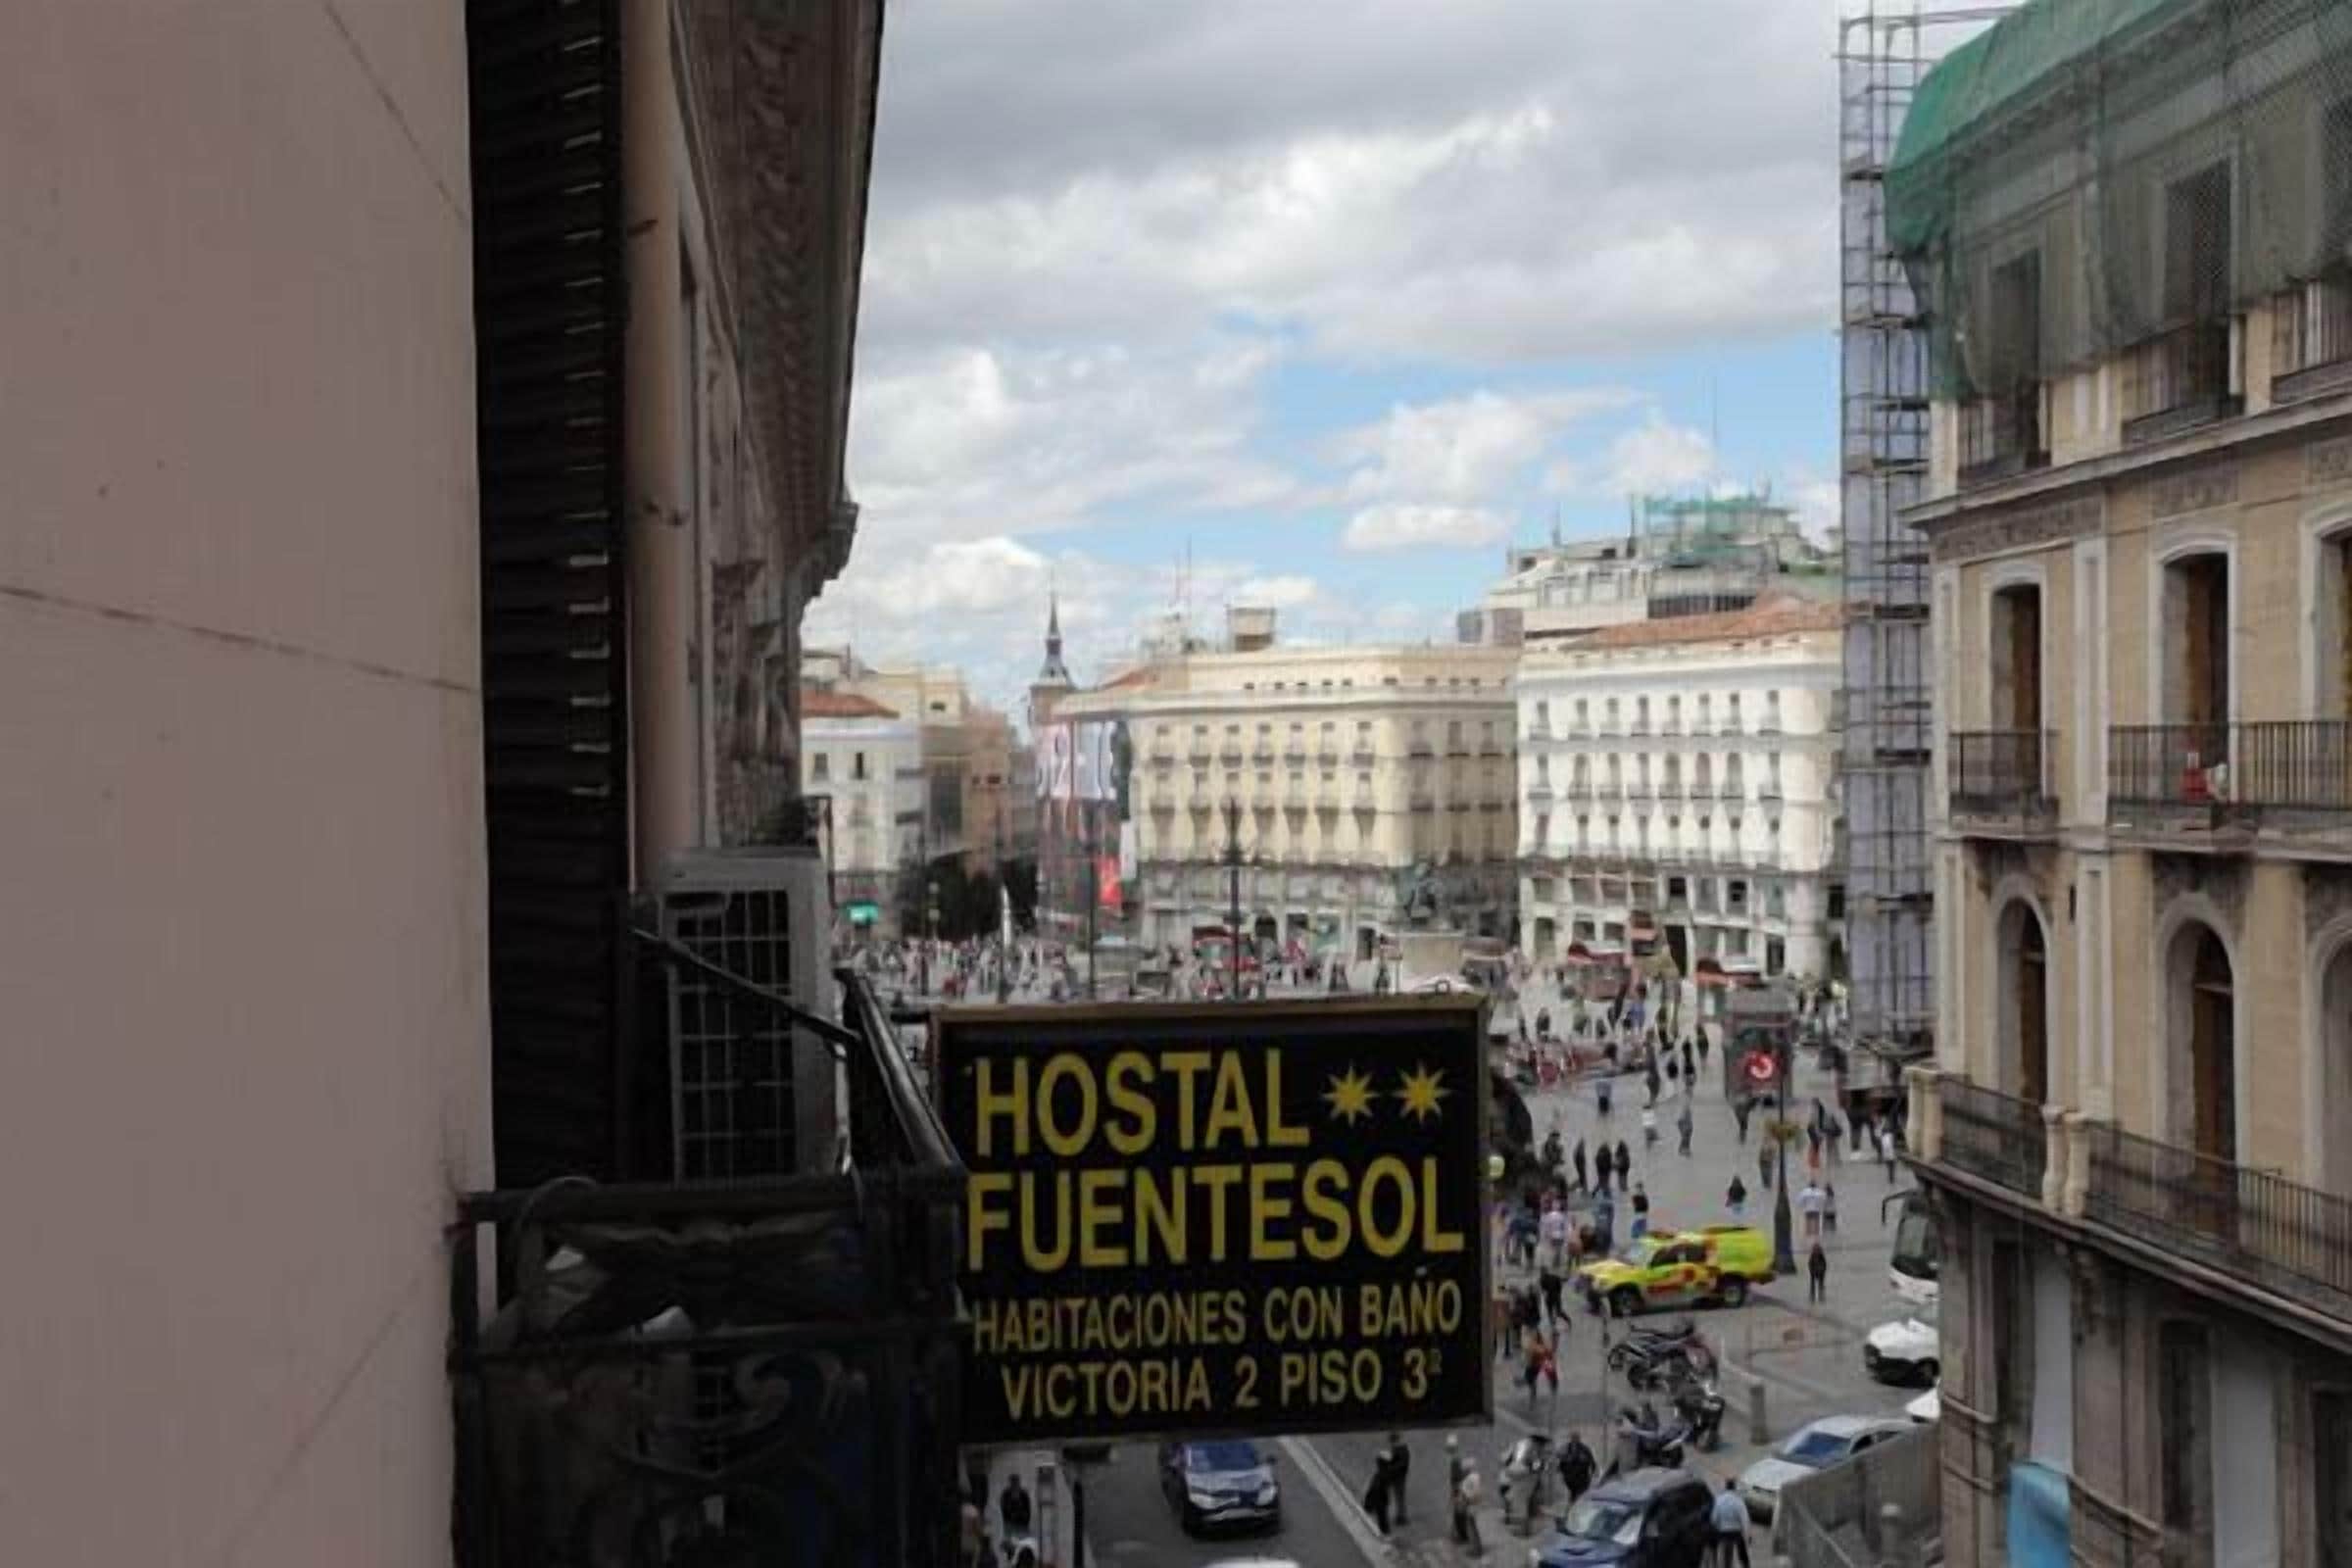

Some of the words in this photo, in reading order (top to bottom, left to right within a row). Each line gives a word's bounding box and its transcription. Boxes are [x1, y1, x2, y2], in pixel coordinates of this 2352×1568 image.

[974, 1050, 1310, 1156] HOSTAL
[967, 1156, 1464, 1271] FUENTESOL
[972, 1291, 1247, 1352] HABITACIONES
[1264, 1286, 1343, 1341] CON
[1359, 1266, 1461, 1337] BAÑO
[1002, 1357, 1212, 1421] VICTORIA
[1235, 1356, 1259, 1408] 2
[1281, 1349, 1382, 1404] PISO
